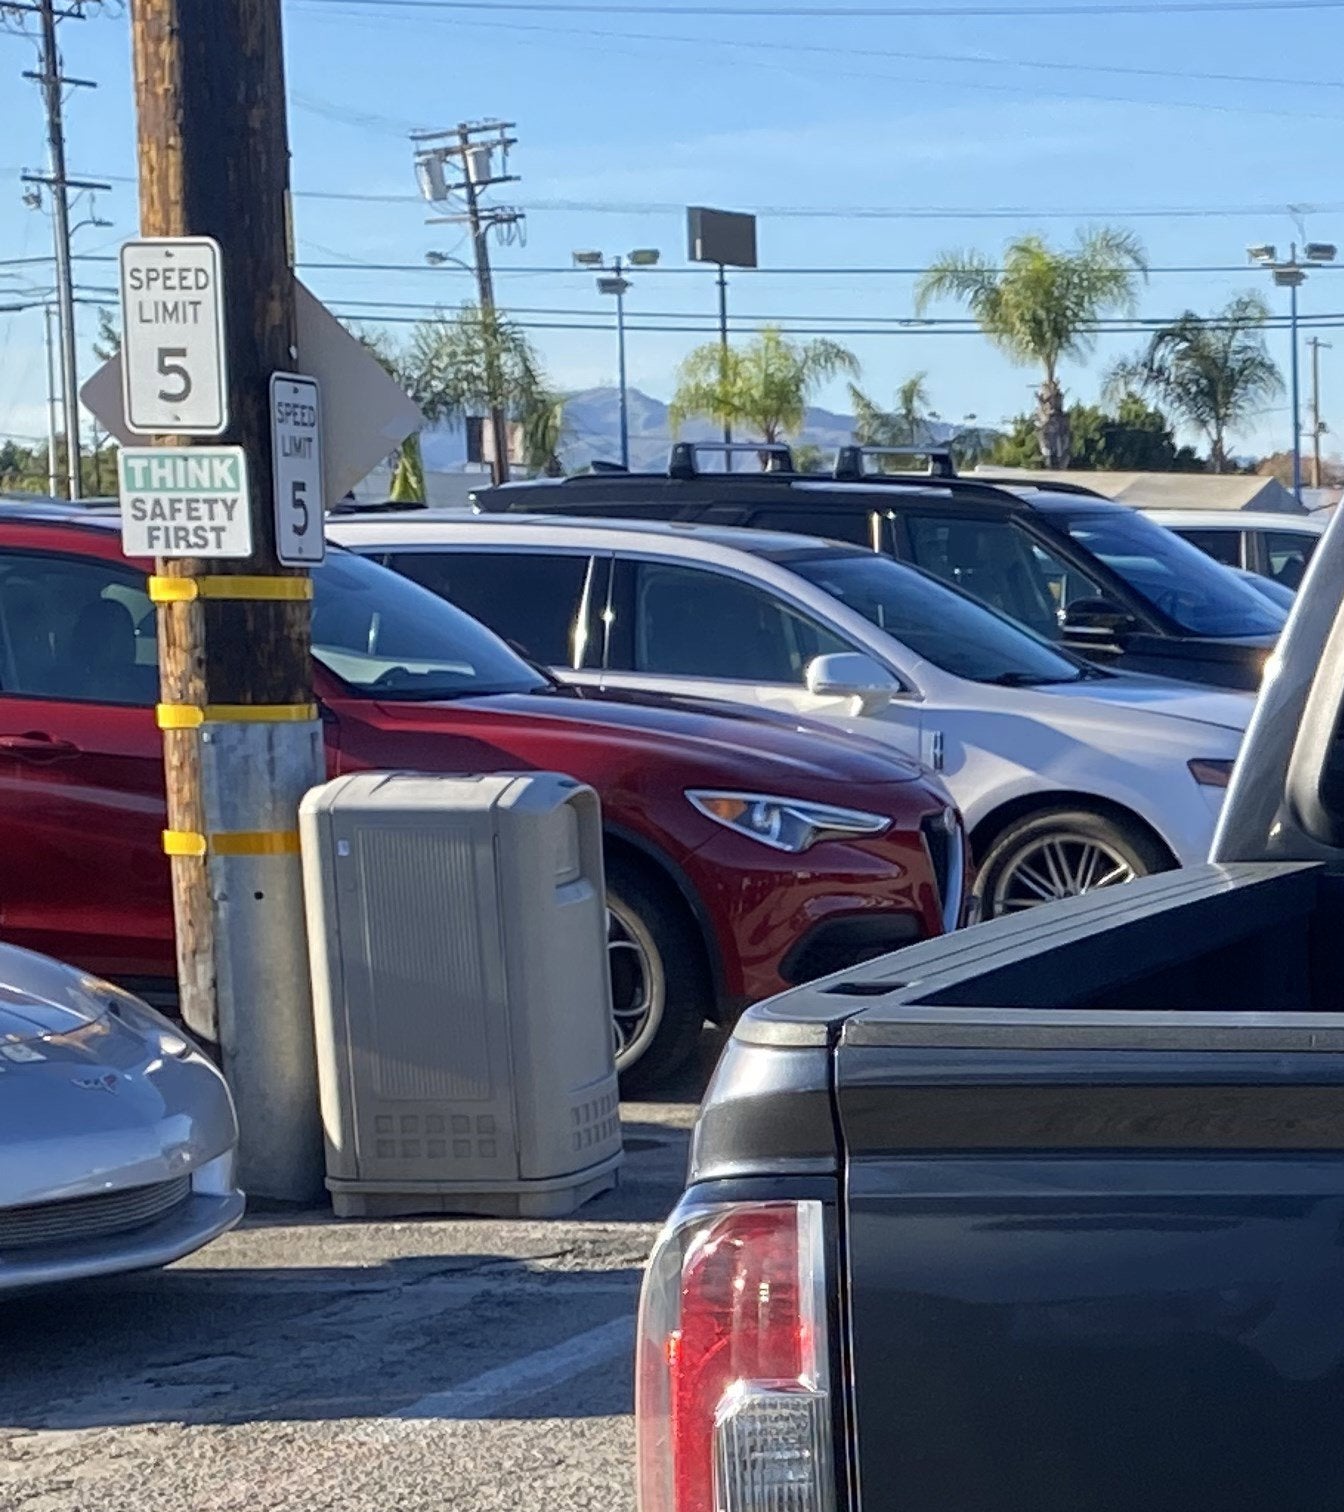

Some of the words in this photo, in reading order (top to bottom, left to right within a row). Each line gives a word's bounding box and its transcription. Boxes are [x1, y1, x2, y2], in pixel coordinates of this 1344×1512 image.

[129, 268, 209, 291] SPEED
[138, 301, 202, 324] LIMIT
[157, 347, 192, 403] 5
[277, 401, 316, 428] SPEED
[281, 433, 313, 460] LIMIT
[126, 457, 238, 489] THINK
[130, 497, 239, 522] SAFETY
[292, 481, 309, 536] 5
[147, 525, 227, 549] FIRST
